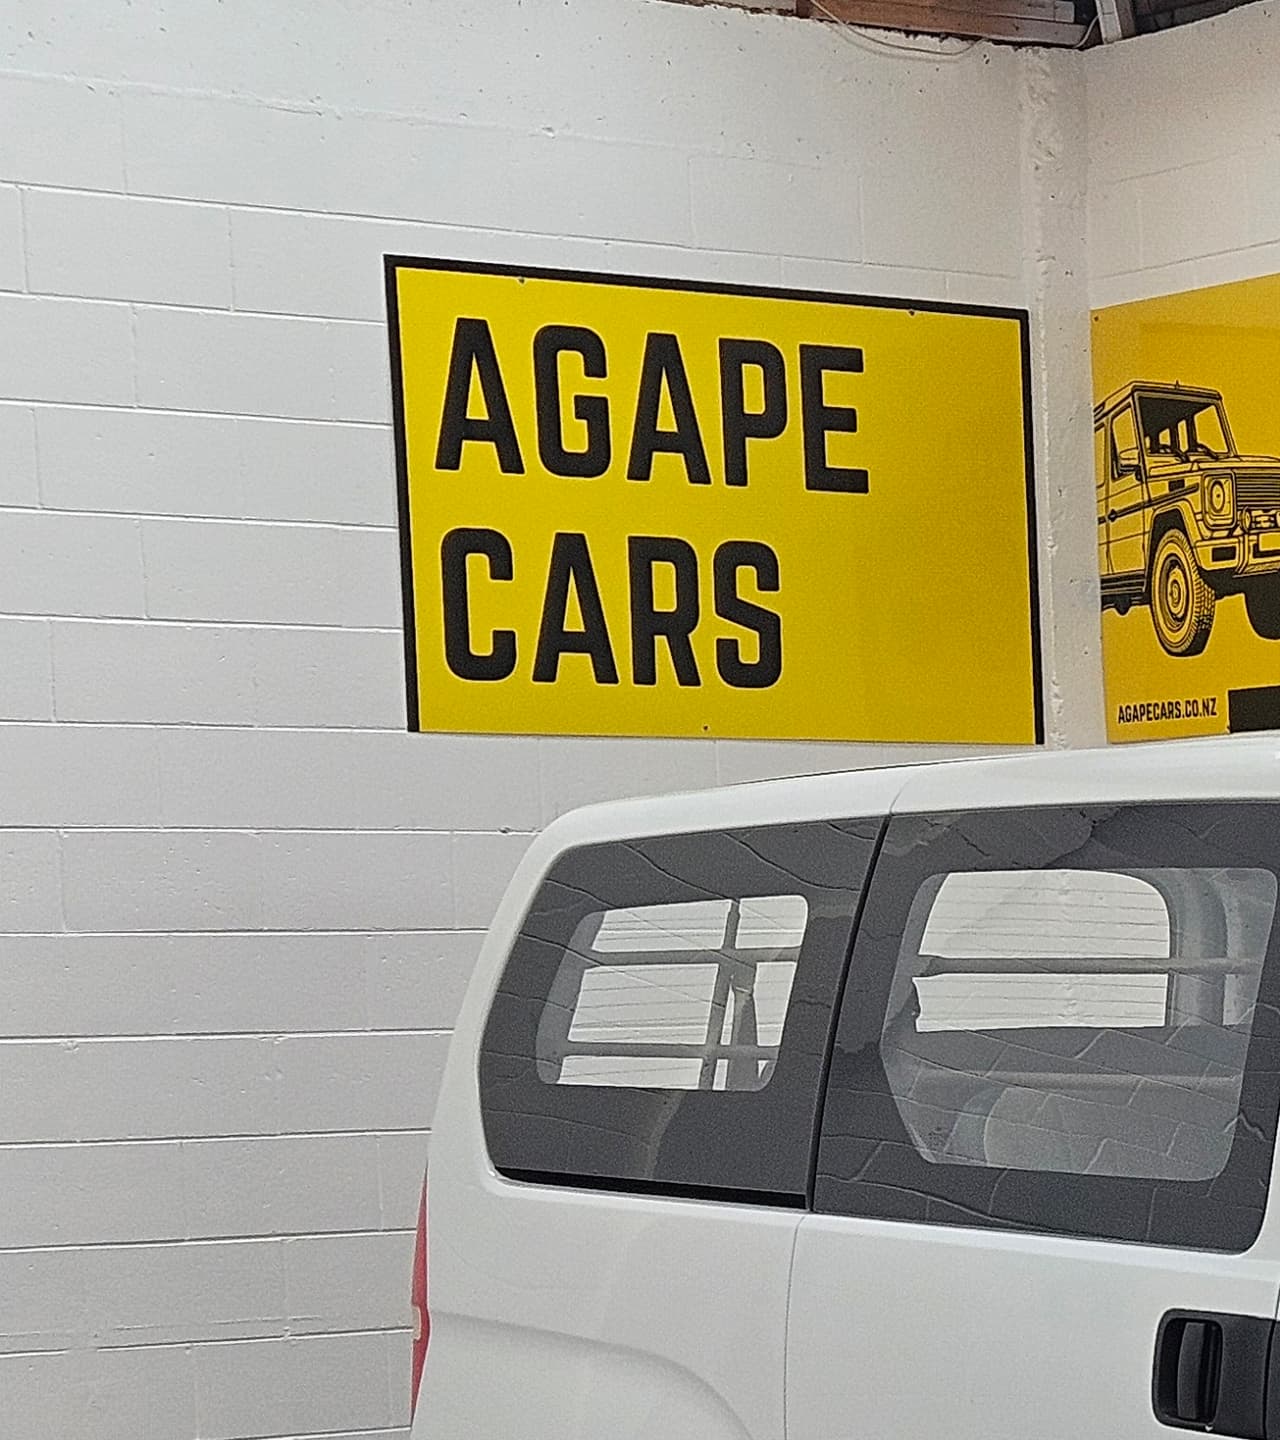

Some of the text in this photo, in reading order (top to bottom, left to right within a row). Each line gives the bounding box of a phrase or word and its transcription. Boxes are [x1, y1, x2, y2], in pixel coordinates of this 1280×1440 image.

[434, 317, 871, 496] AGAPE
[439, 526, 783, 690] CARS
[1117, 697, 1217, 724] AGAPECARS.CO.NZ
